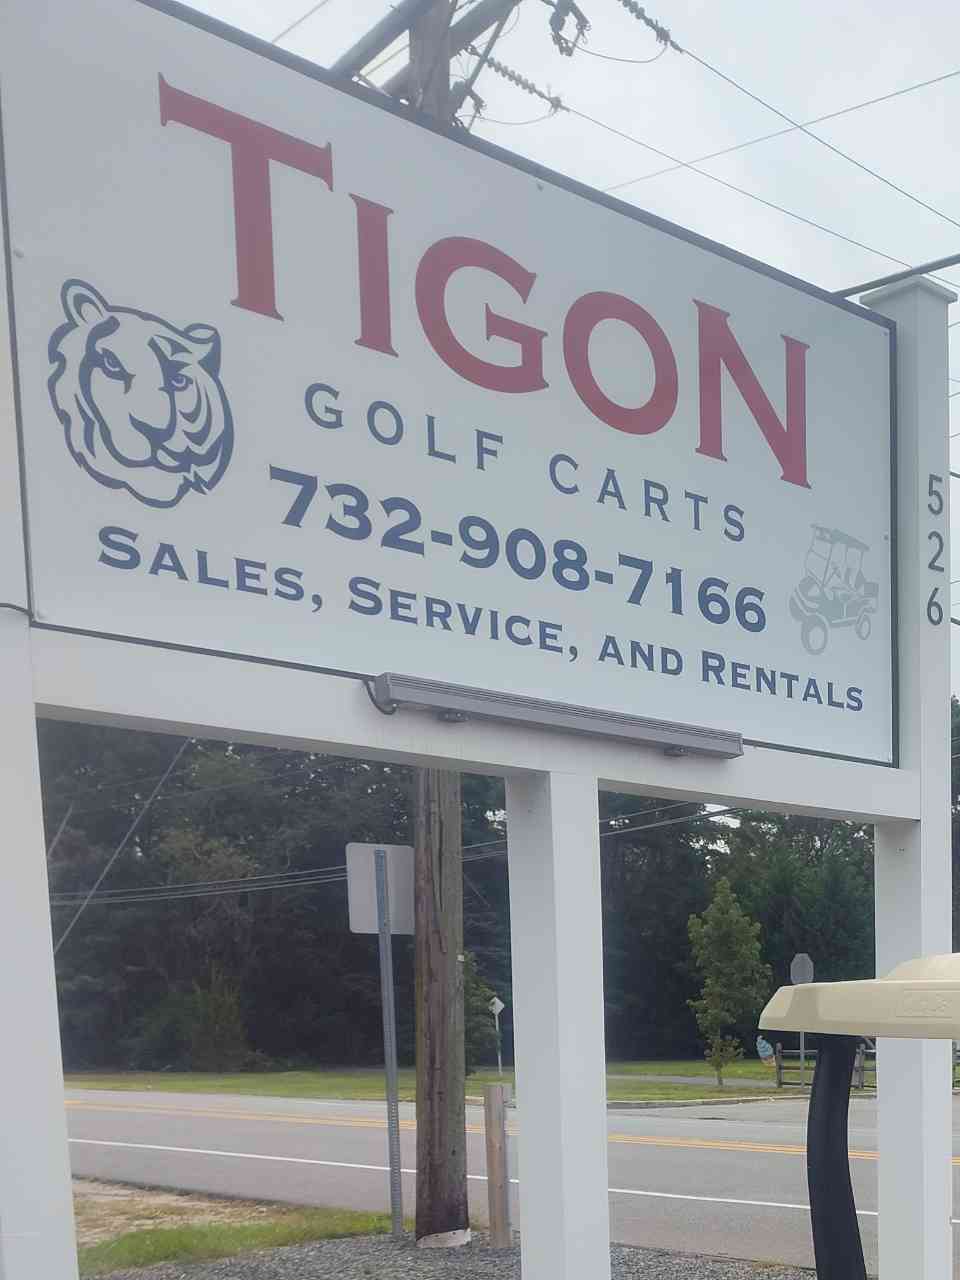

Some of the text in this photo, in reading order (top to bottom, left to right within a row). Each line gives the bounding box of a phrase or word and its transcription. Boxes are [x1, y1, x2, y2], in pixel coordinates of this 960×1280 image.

[157, 73, 812, 490] TIGON
[269, 464, 766, 633] 732-908-7166
[304, 382, 747, 542] GOLF CARTS
[97, 525, 864, 712] SALES, SERVICE, AND RENTALS
